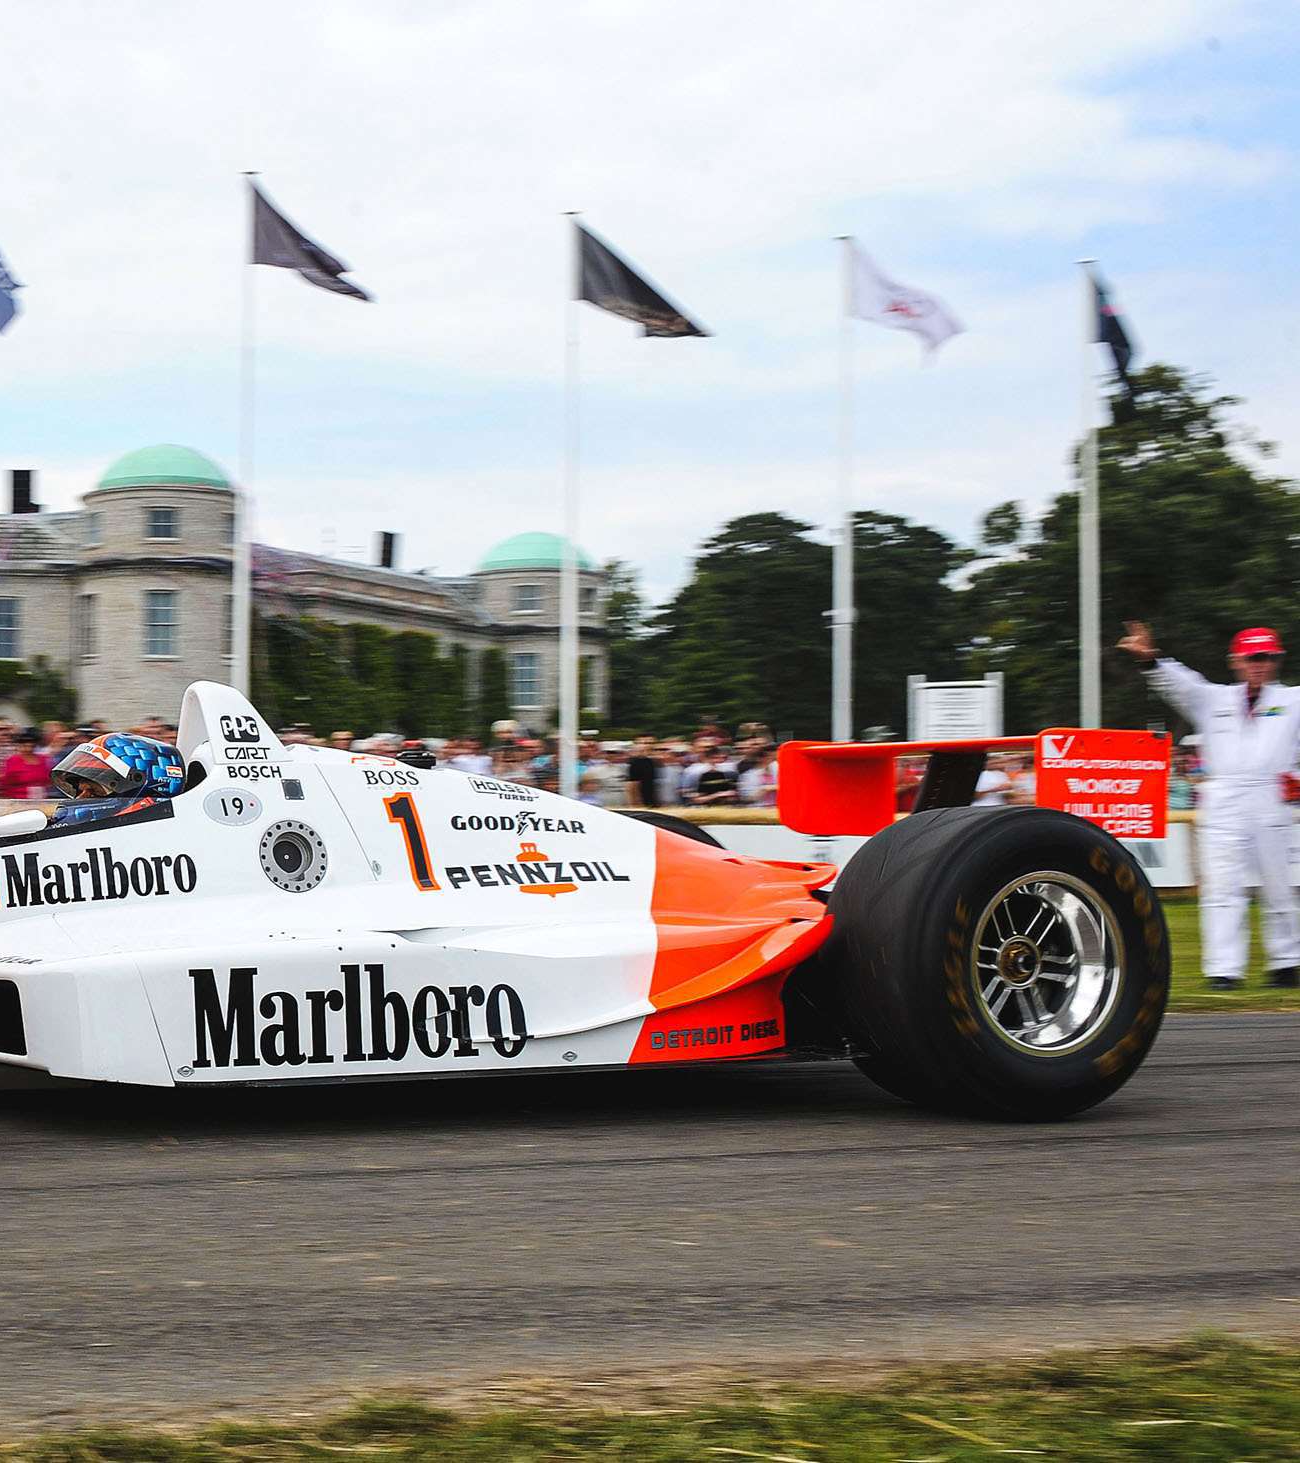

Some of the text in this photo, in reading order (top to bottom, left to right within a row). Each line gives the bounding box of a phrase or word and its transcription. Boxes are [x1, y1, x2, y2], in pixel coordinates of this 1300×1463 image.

[220, 716, 260, 742] PPG
[224, 747, 270, 760] CART
[227, 765, 282, 778] BOSCH
[362, 769, 419, 786] BOSS
[220, 797, 244, 817] 19
[382, 792, 441, 891] 1
[1, 847, 197, 908] Marlboro
[444, 862, 631, 889] PENNZOIL
[188, 963, 528, 1068] Marlboro
[651, 1025, 734, 1050] DETROIT
